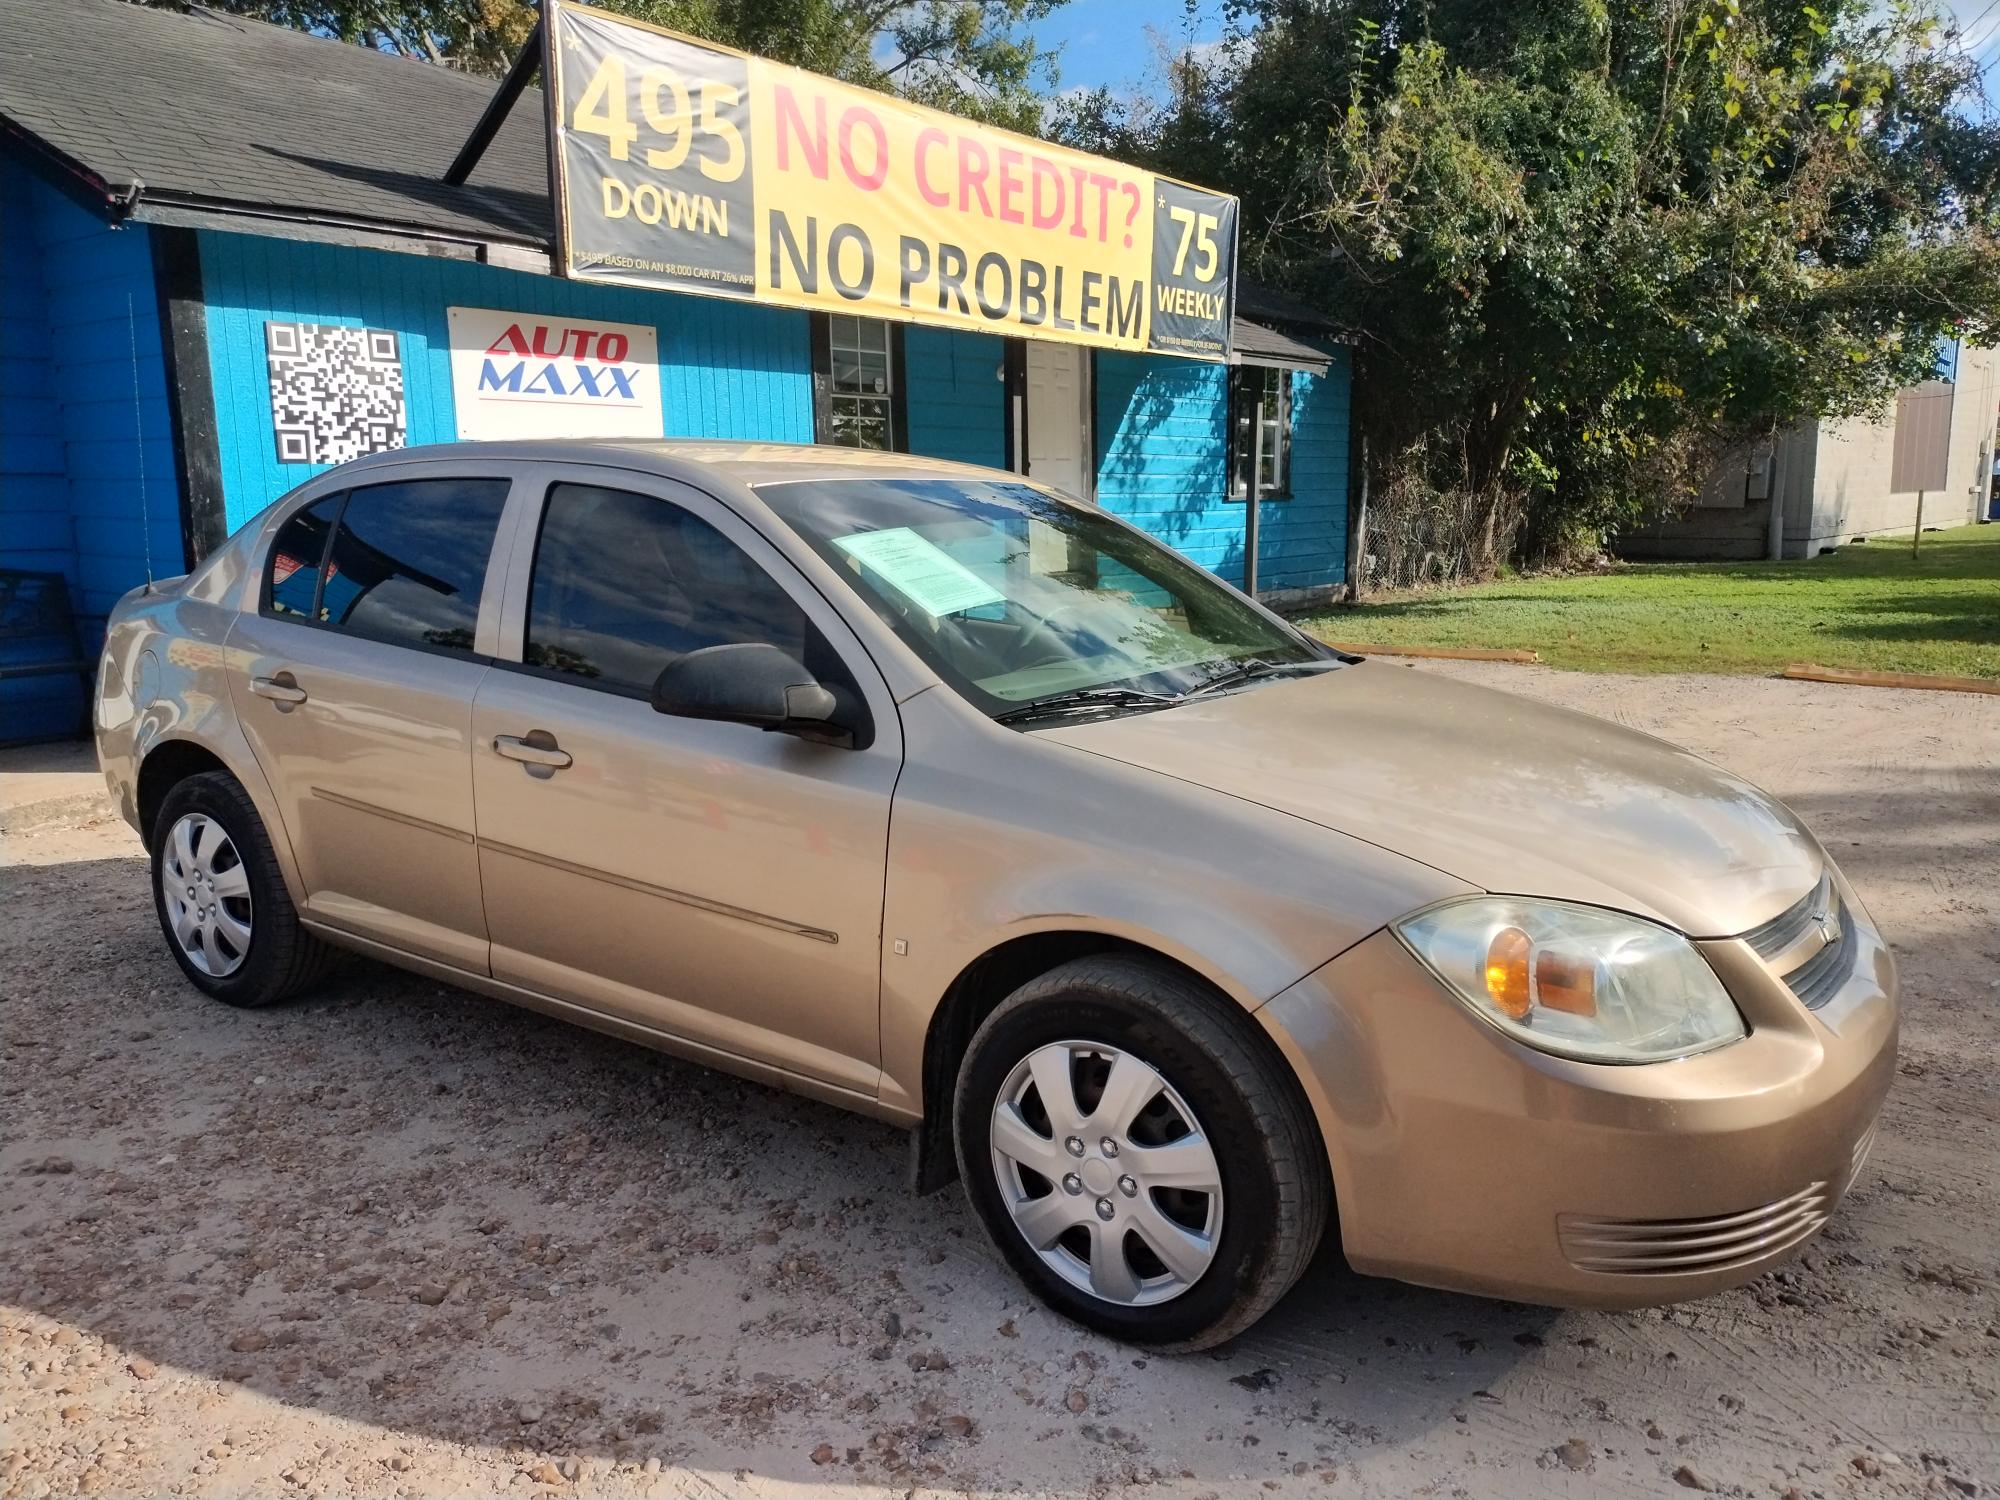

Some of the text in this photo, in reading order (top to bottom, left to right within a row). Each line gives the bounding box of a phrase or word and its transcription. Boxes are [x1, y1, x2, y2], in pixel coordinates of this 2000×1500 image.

[774, 84, 1141, 249] NO CREDIT?
[600, 176, 729, 238] DOWN
[605, 254, 634, 268] BASED
[635, 259, 650, 270] ON
[651, 261, 664, 273] AN
[665, 263, 692, 277] $8,000
[693, 267, 709, 279] CAR
[710, 270, 721, 280] AT
[722, 271, 738, 283] 26%
[738, 273, 755, 285] APR
[769, 208, 1144, 340] NO PROBLEM
[1157, 284, 1225, 321] WEEKLY
[485, 323, 629, 364] AUTO
[477, 358, 641, 400] MAXX
